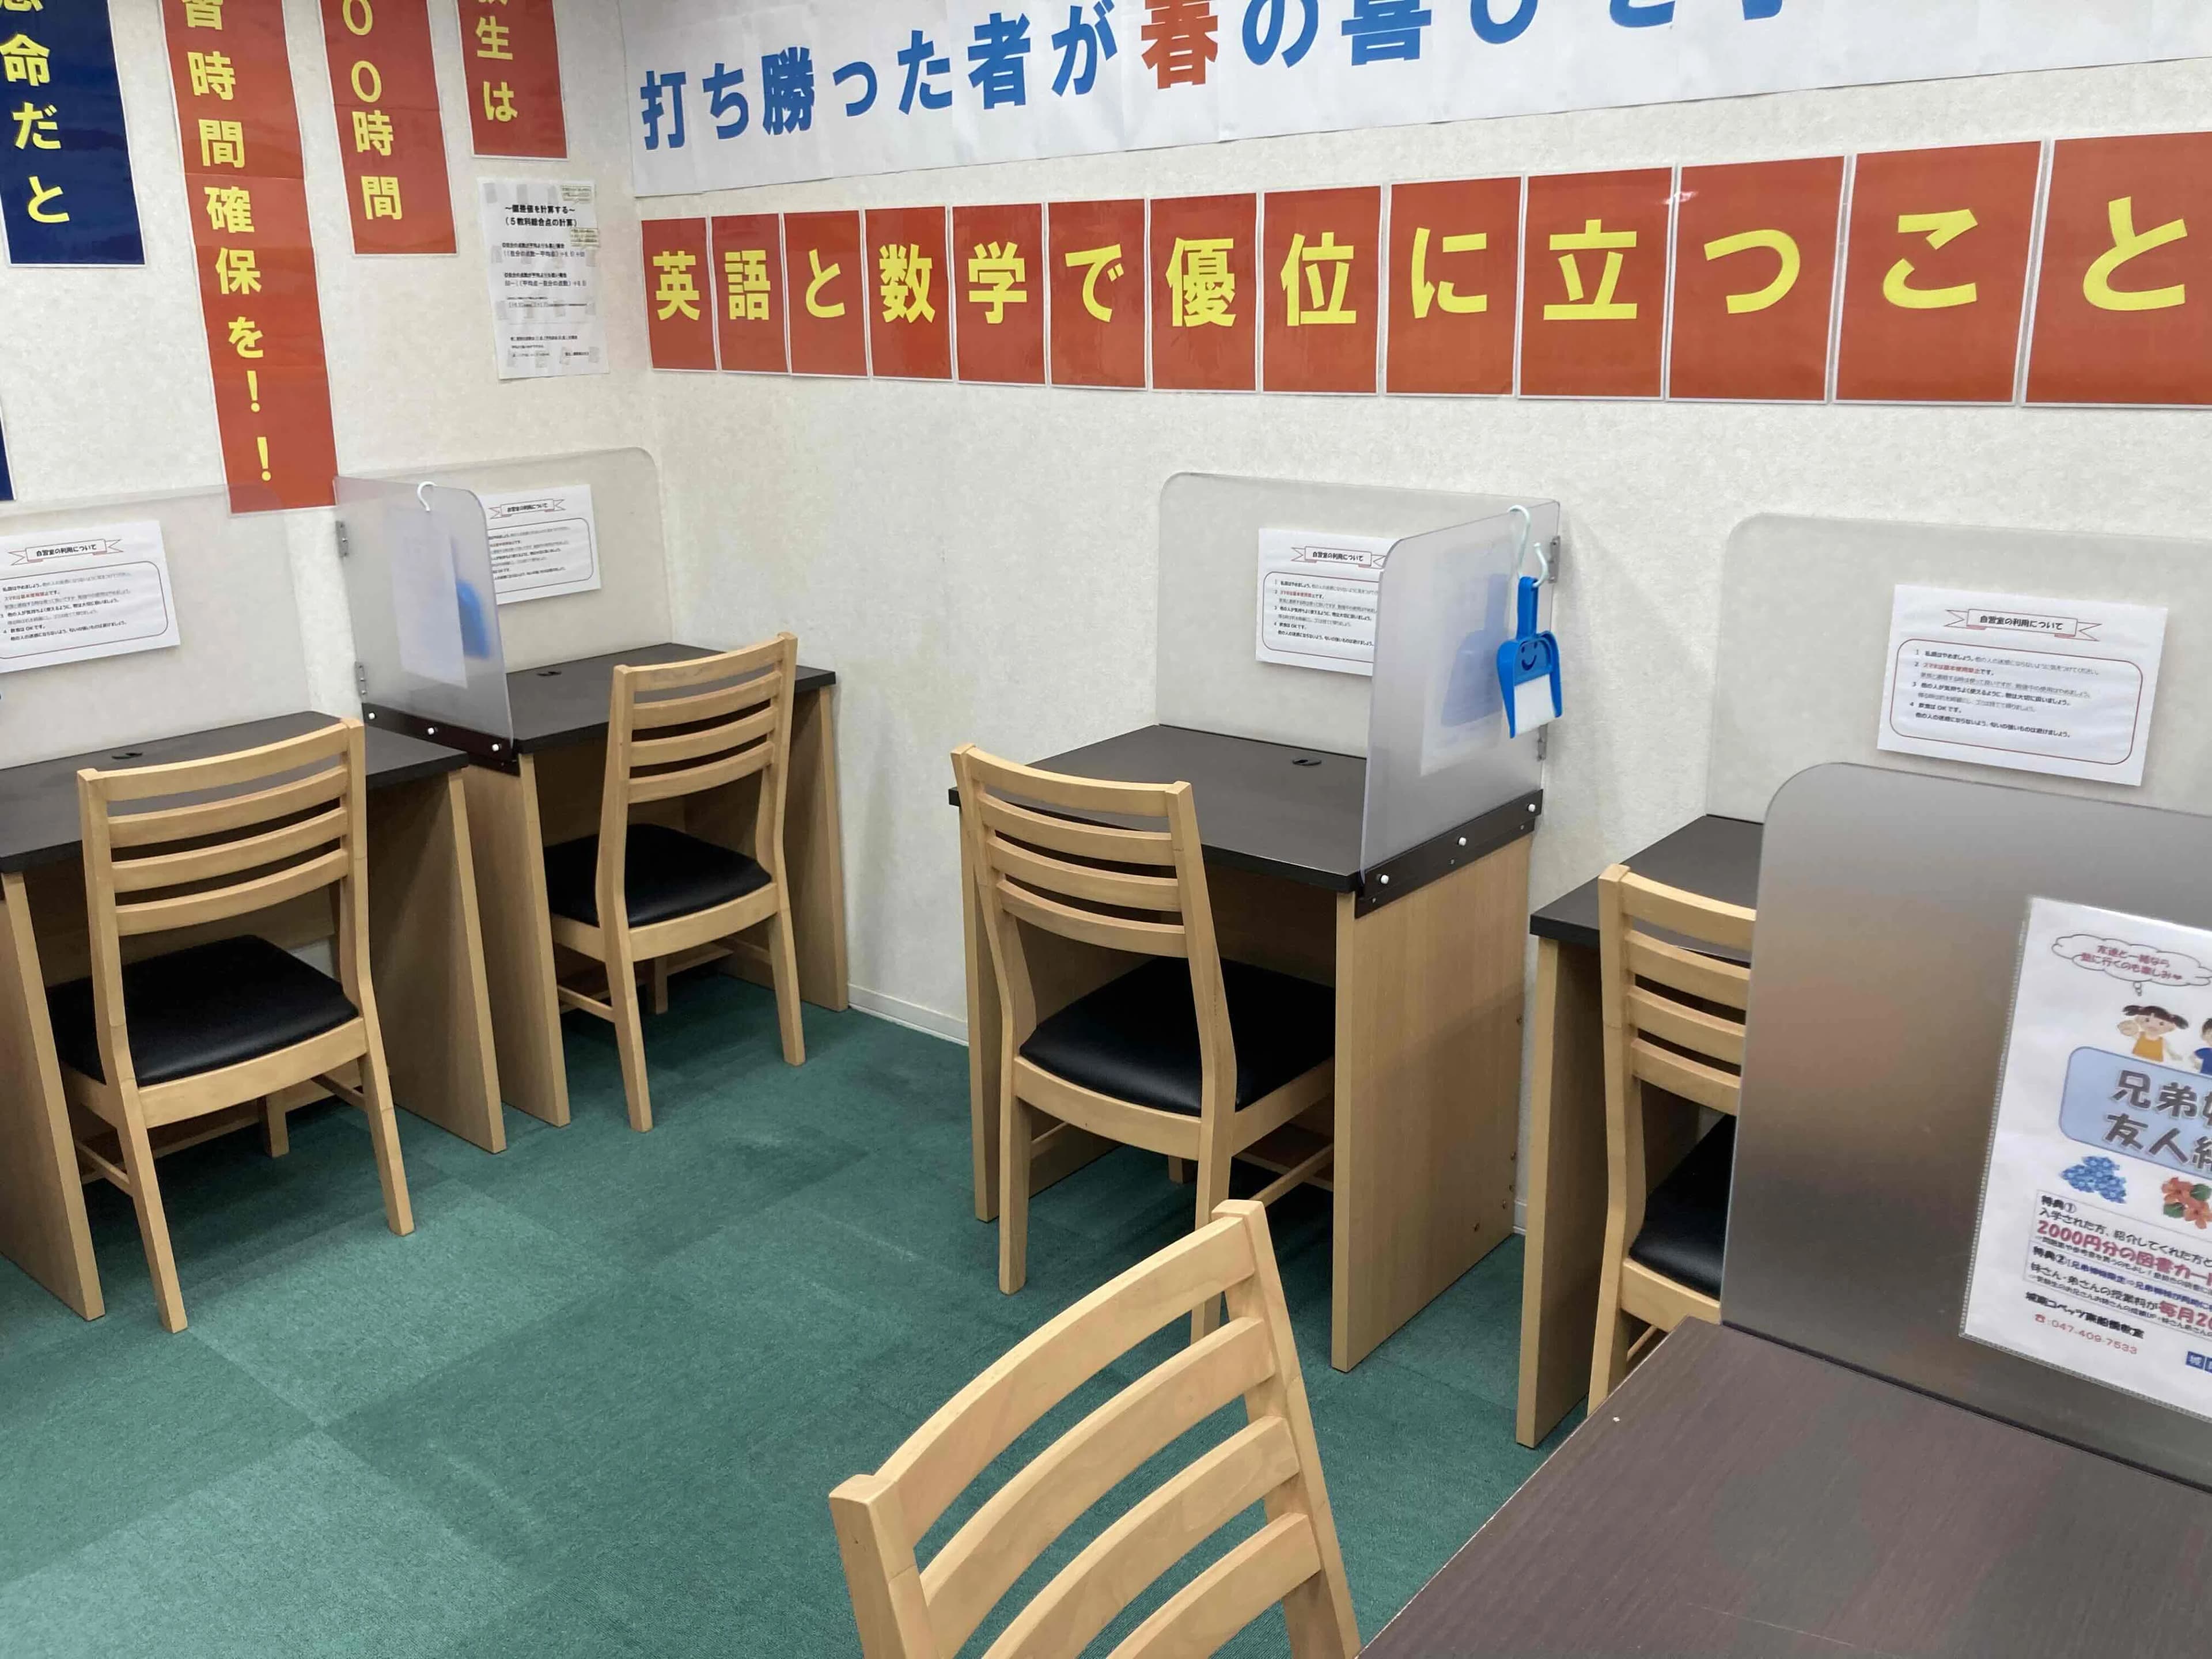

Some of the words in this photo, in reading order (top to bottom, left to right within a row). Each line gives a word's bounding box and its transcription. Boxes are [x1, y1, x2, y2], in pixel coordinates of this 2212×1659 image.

[0, 0, 70, 224] 命だと
[476, 0, 517, 122] 生は
[639, 0, 1783, 151] 打ち勝った者が春の喜
[652, 196, 2187, 328] 英語と数学で優位に立つこと
[1980, 616, 2063, 630] 自習室の利用について
